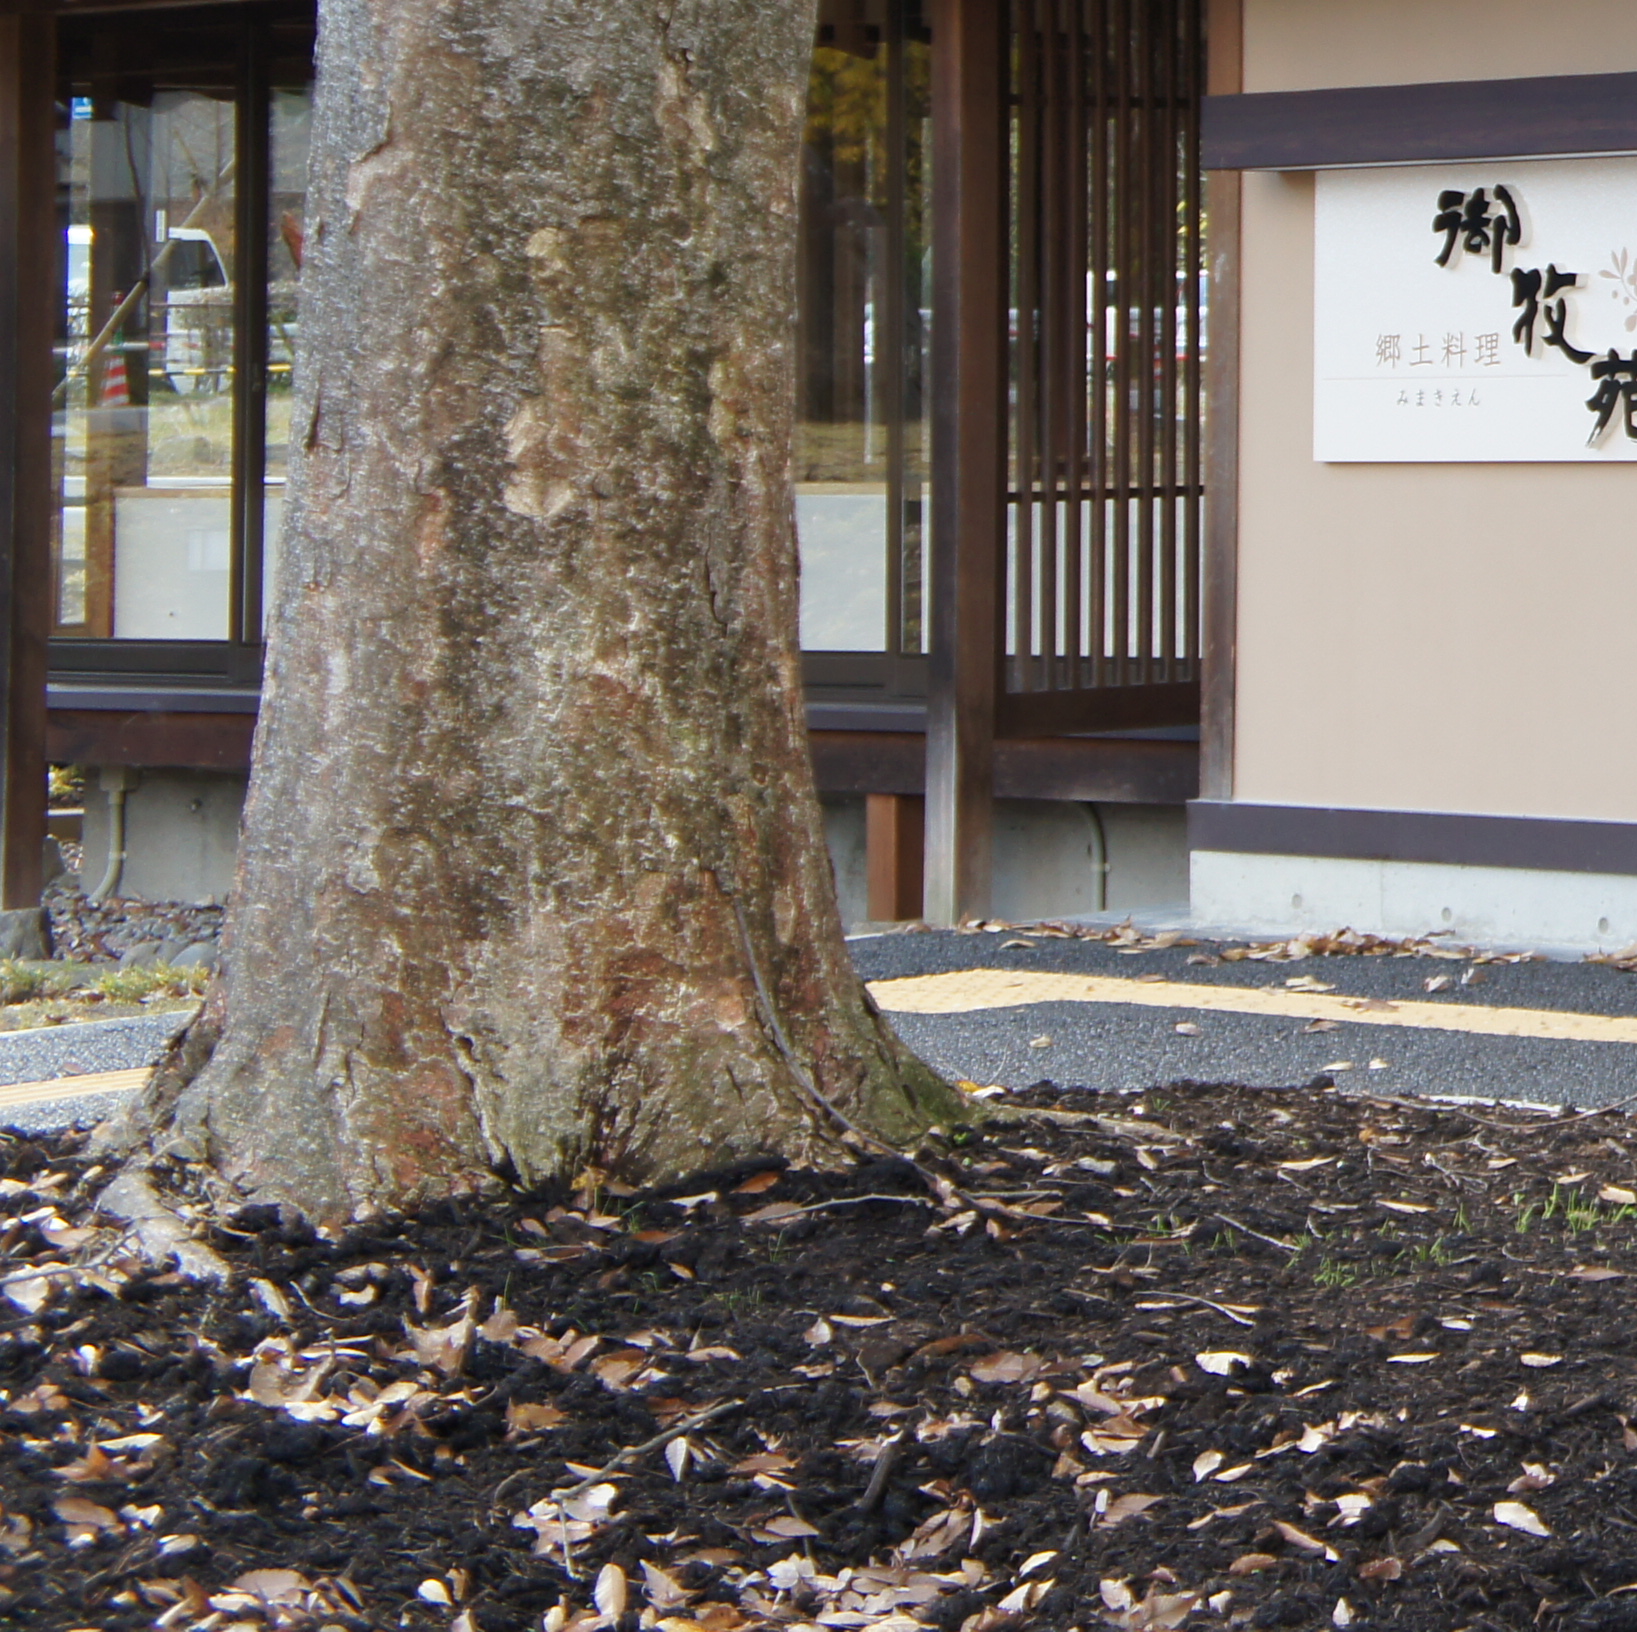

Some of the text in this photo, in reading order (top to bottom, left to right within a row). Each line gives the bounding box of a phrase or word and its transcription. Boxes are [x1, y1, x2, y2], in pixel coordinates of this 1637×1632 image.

[1375, 331, 1501, 369] 郷土料理
[1396, 388, 1481, 407] みまきえん
